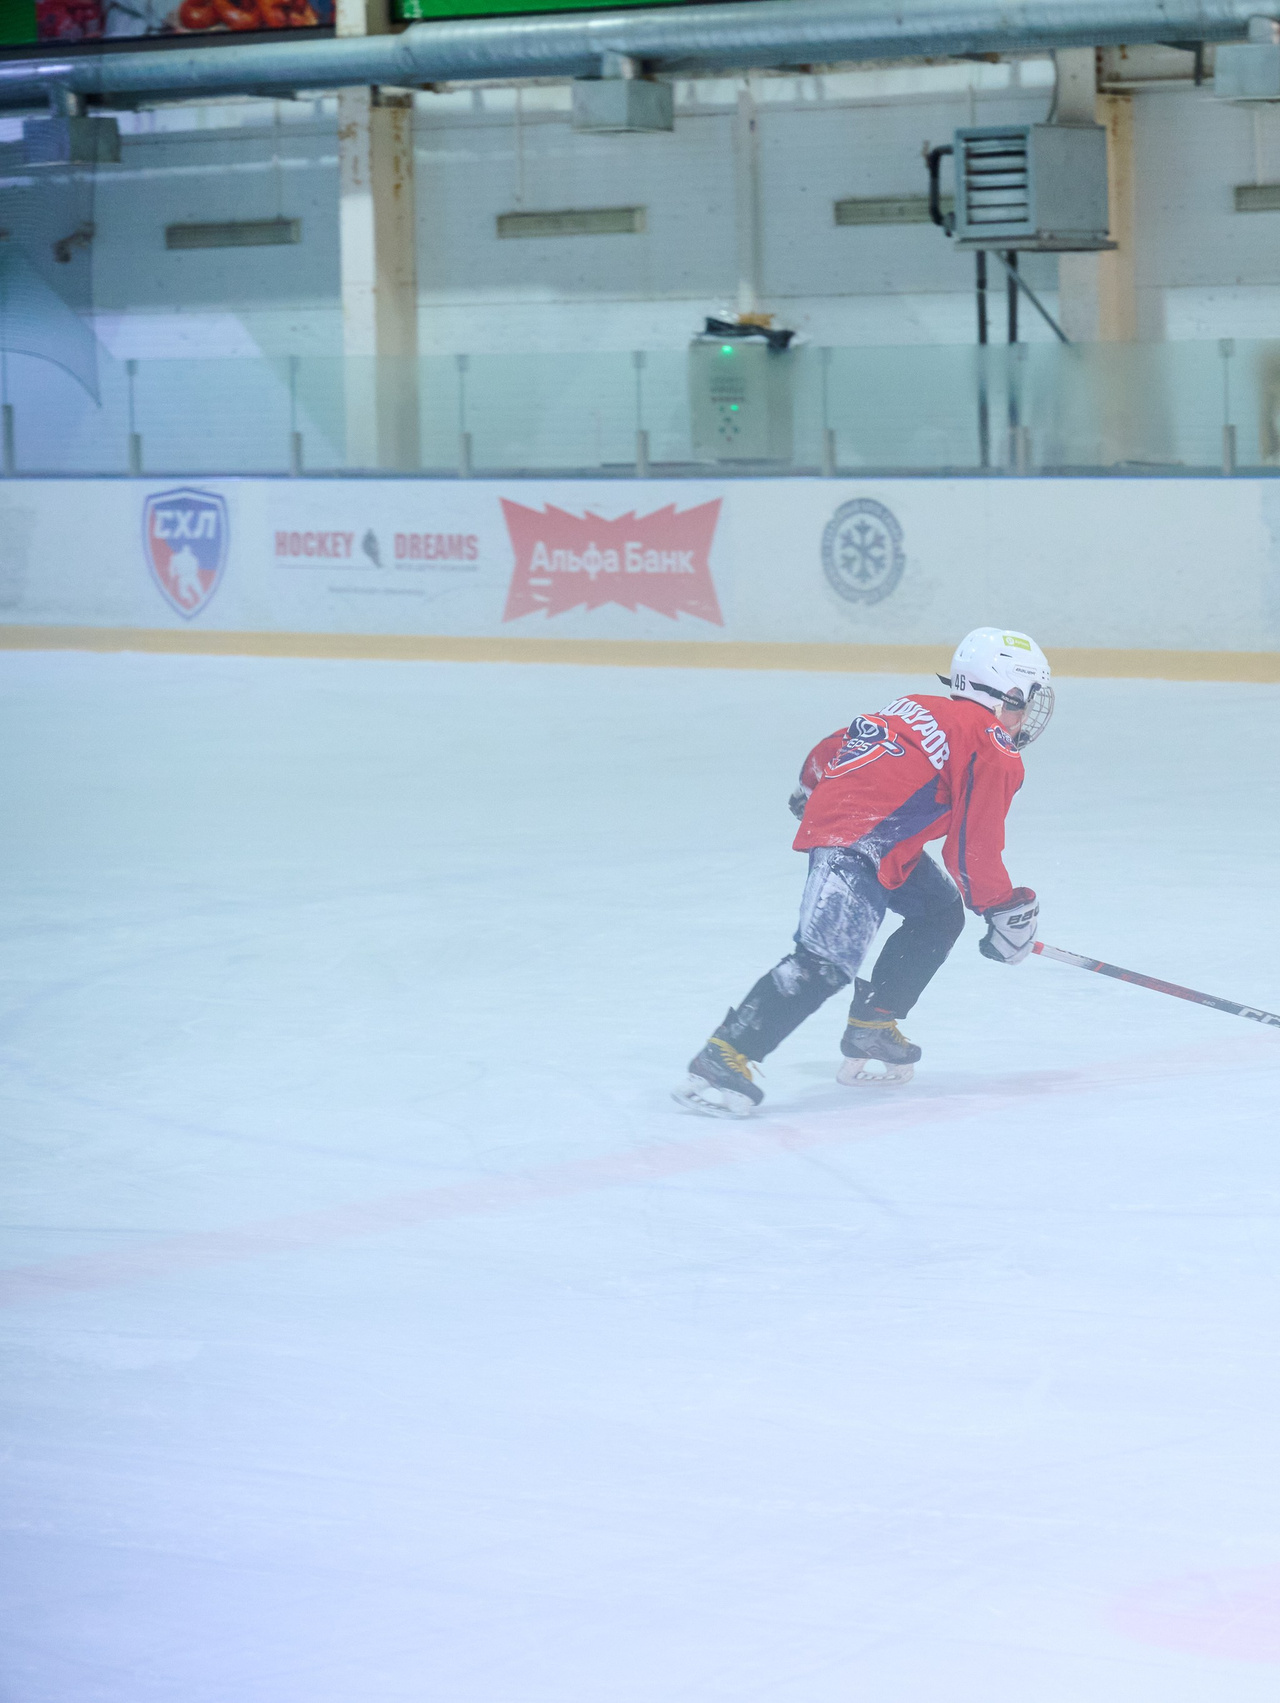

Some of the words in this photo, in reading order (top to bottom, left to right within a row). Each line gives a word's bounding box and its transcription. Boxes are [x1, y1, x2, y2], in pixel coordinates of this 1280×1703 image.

[152, 509, 217, 541] СХЛ
[275, 531, 355, 559] HOCKEY
[393, 533, 479, 561] DREAMS
[530, 541, 620, 581] Альфа
[625, 541, 695, 576] Банк
[954, 673, 966, 692] 46
